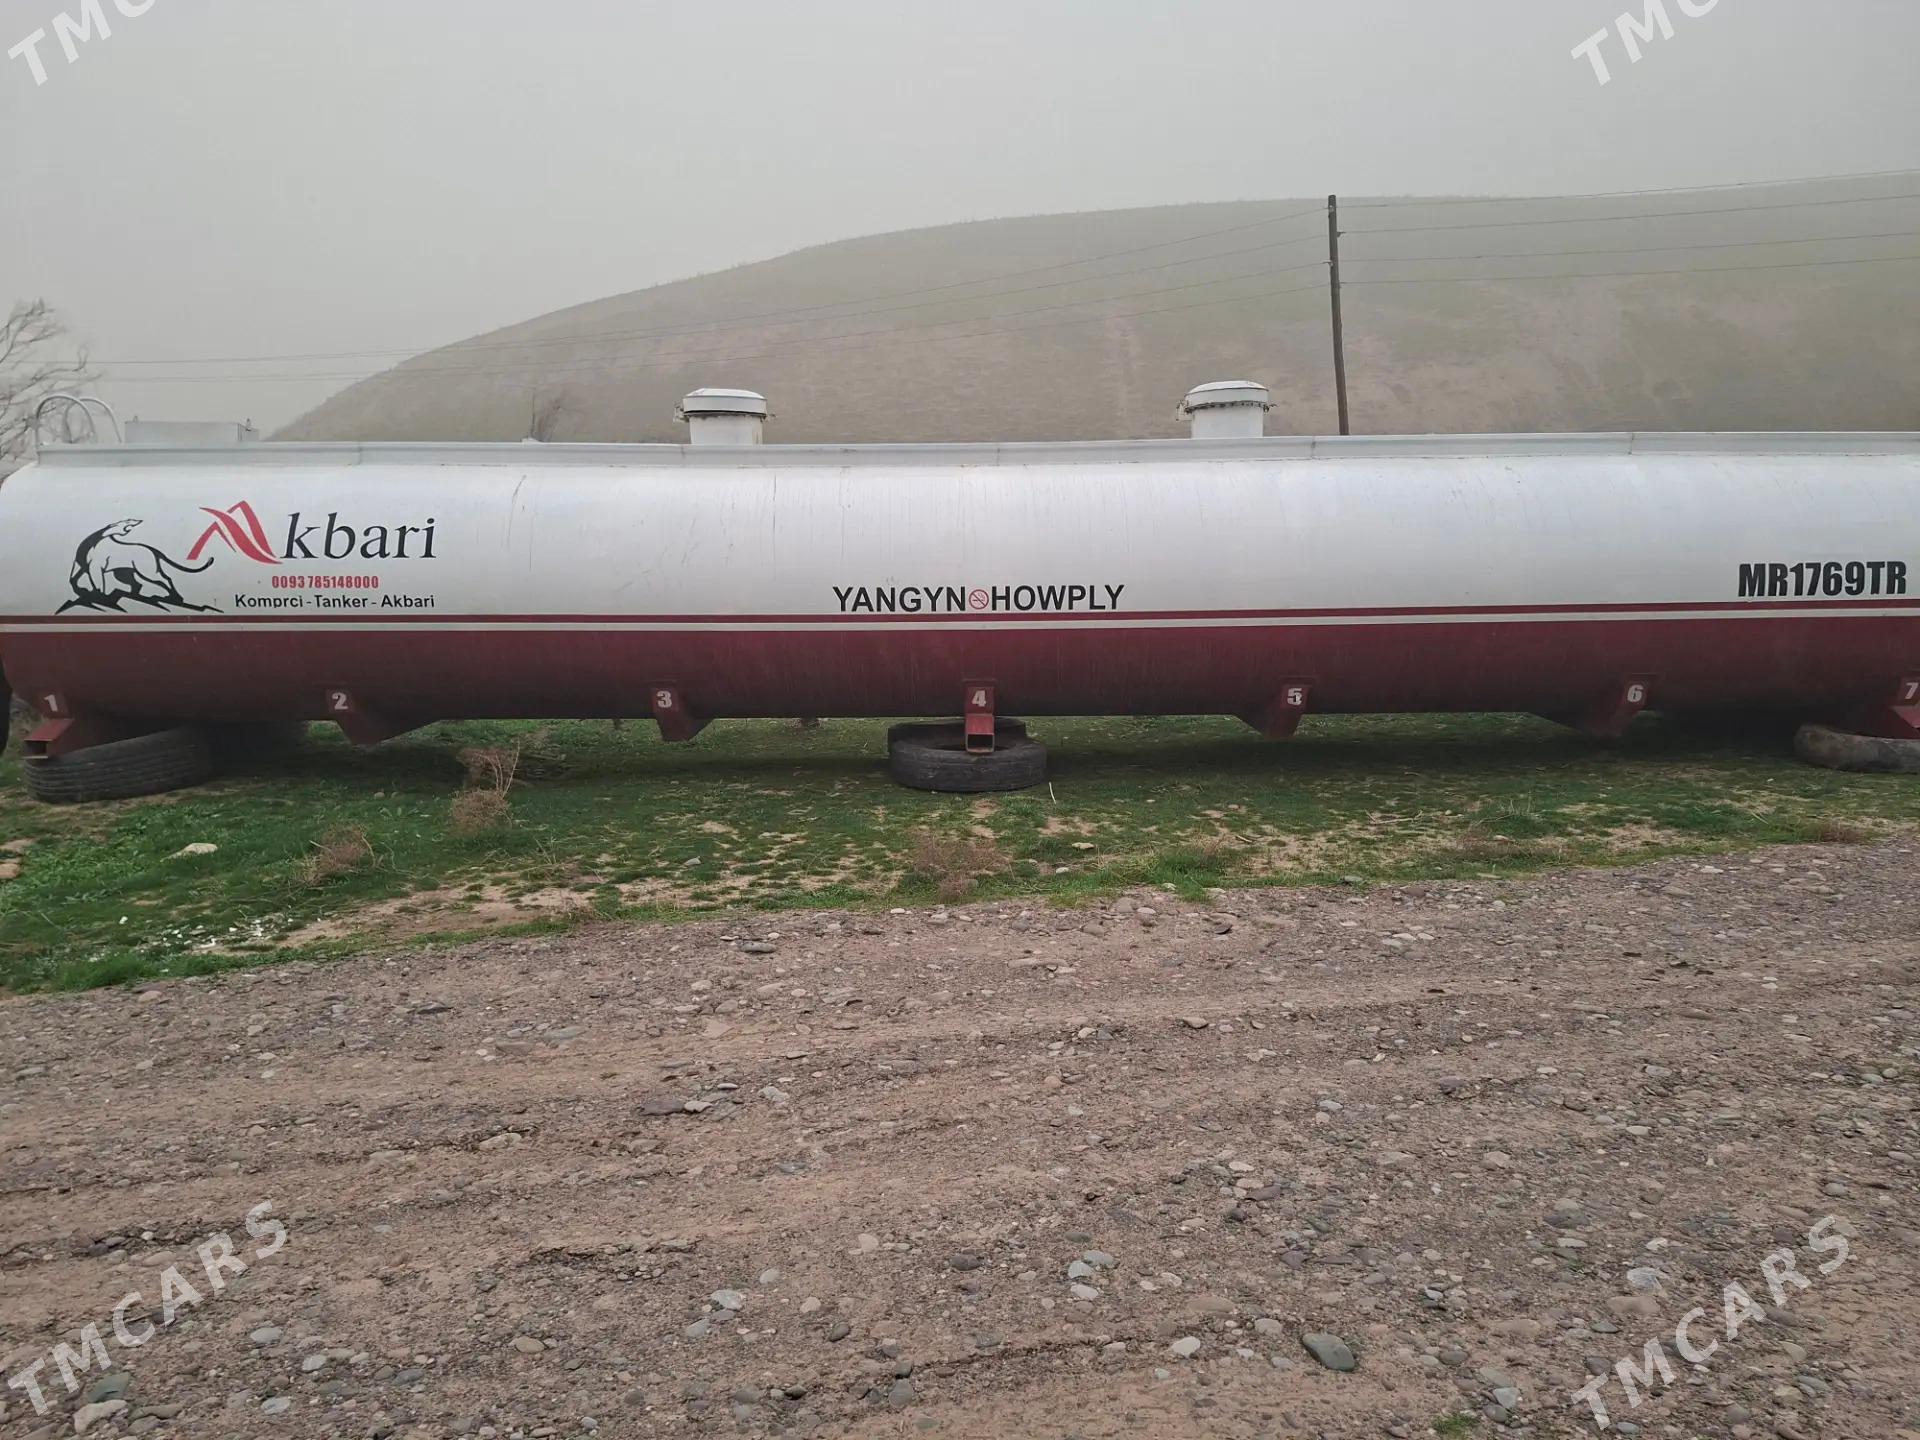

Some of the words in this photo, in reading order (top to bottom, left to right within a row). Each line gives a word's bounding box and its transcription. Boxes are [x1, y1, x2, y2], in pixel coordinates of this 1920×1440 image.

[1738, 561, 1907, 597] MR1769TR
[314, 595, 368, 608] Tanker
[381, 594, 435, 608] Akbari
[832, 586, 966, 613] YANGYN
[991, 584, 1125, 611] HOWPLY
[656, 690, 673, 708] 3
[971, 689, 987, 707] 4
[1286, 687, 1303, 706] 5
[1627, 684, 1644, 703] 6
[1904, 682, 1919, 700] 7
[43, 694, 59, 712] 1
[332, 692, 349, 710] 2
